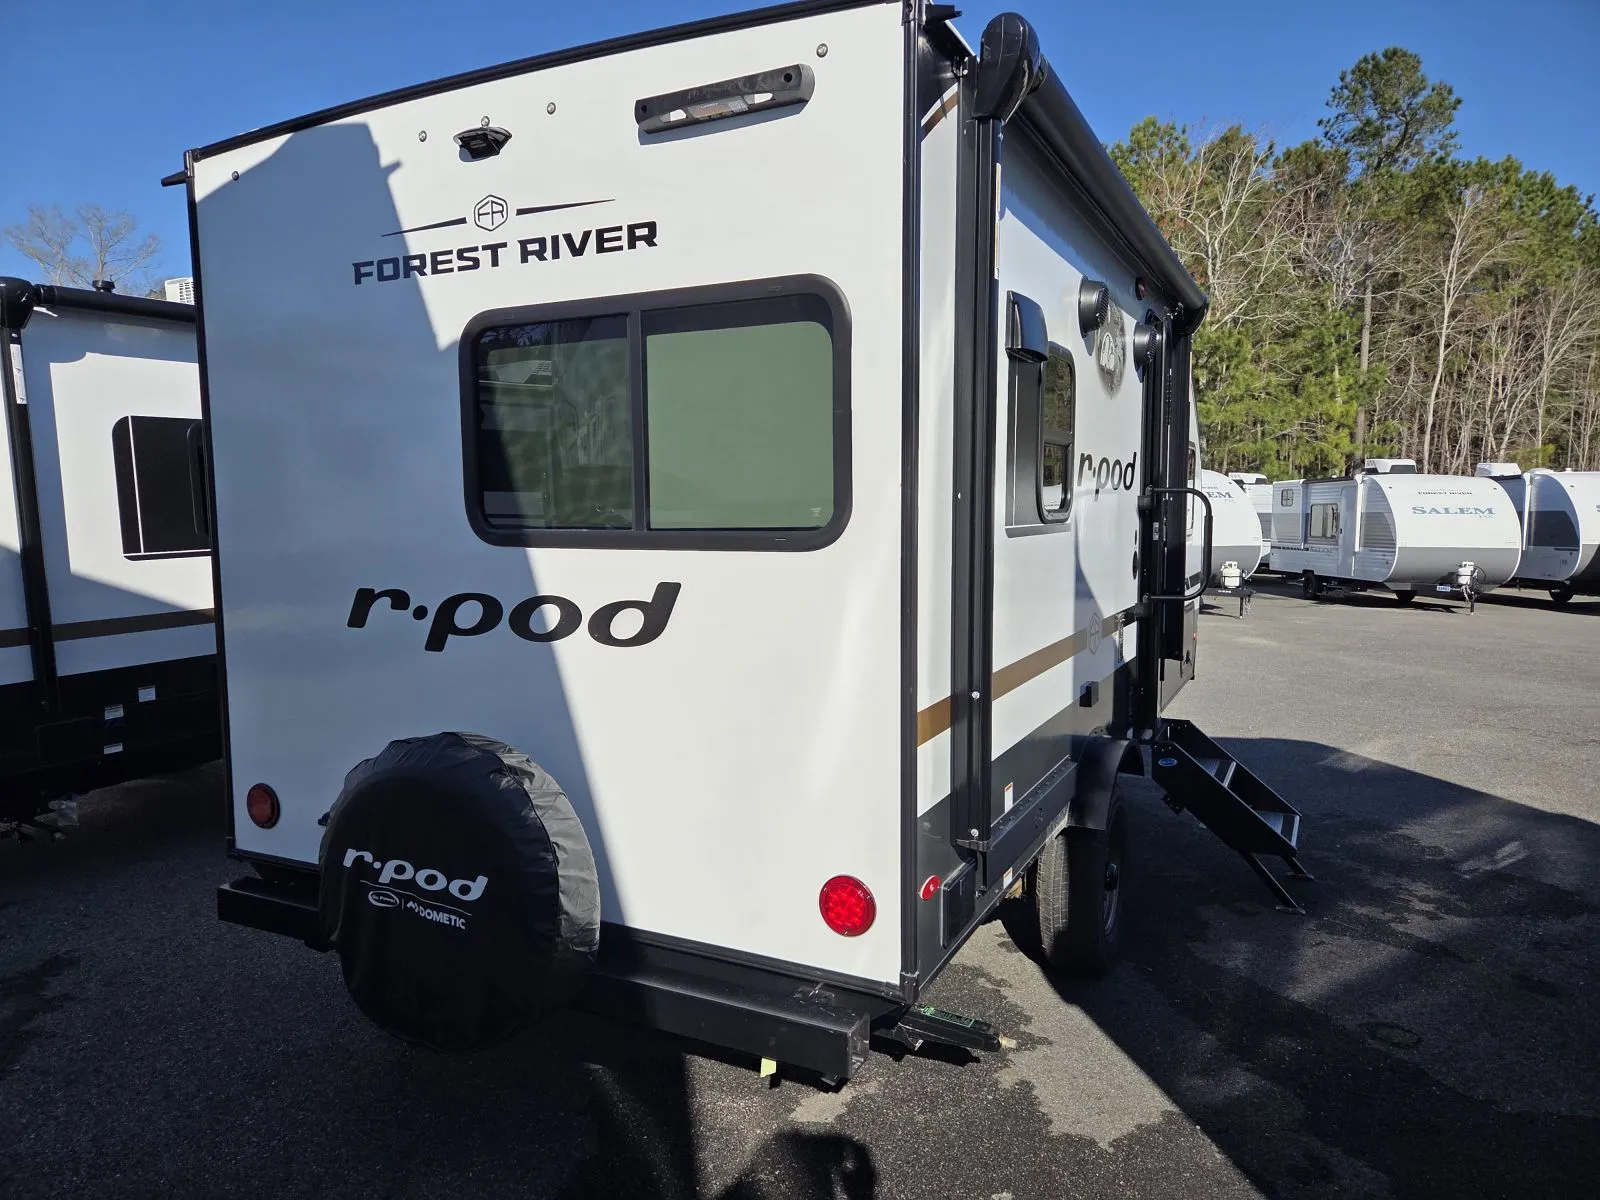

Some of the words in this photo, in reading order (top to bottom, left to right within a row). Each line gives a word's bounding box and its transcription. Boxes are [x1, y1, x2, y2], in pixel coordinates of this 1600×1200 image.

[351, 241, 508, 285] FOREST
[517, 220, 658, 264] RIVER
[1411, 506, 1496, 515] SALEM
[419, 906, 466, 930] DOMETIC
